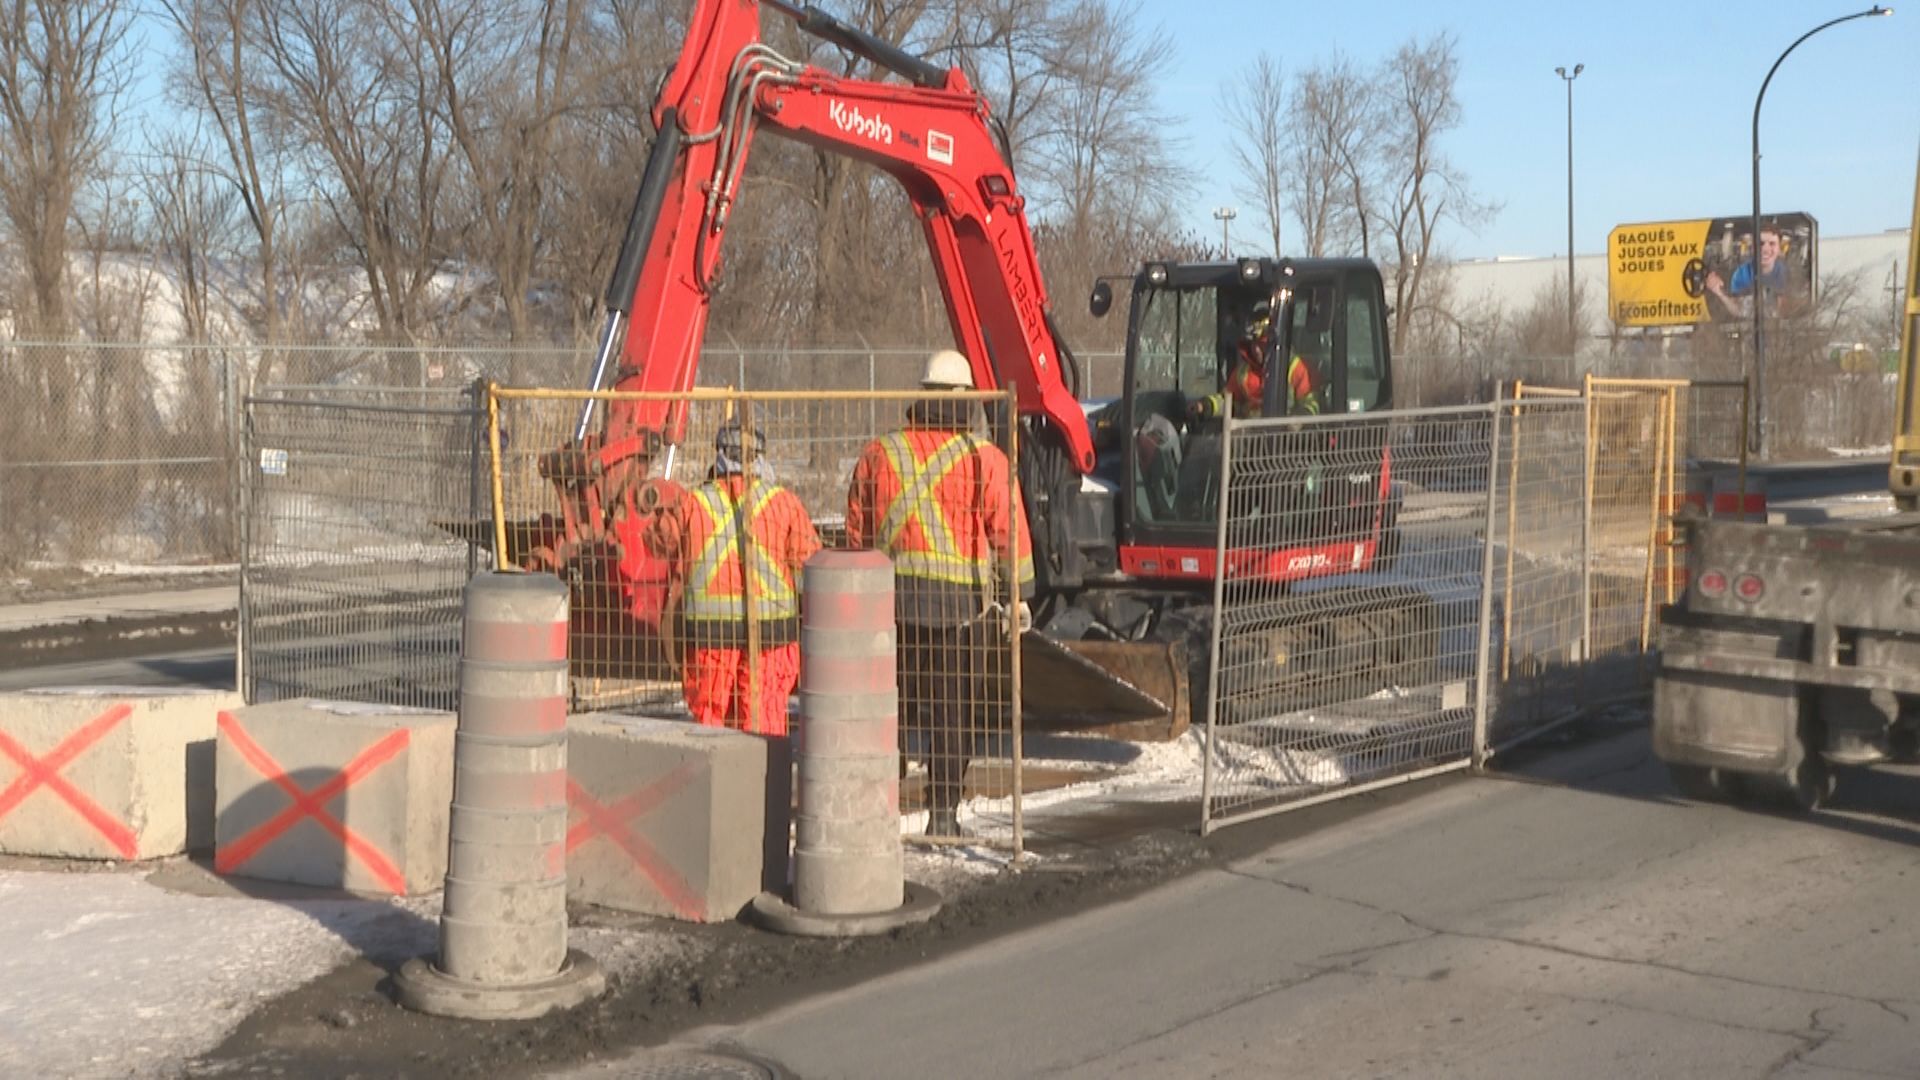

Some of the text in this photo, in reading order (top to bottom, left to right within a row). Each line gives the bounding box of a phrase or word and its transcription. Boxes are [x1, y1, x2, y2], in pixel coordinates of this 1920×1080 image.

[829, 98, 892, 145] Kubota
[1618, 229, 1675, 245] RAQUÉS
[1618, 260, 1665, 273] JOUES
[997, 228, 1044, 345] LAMBERT
[1618, 299, 1702, 318] Econofitness
